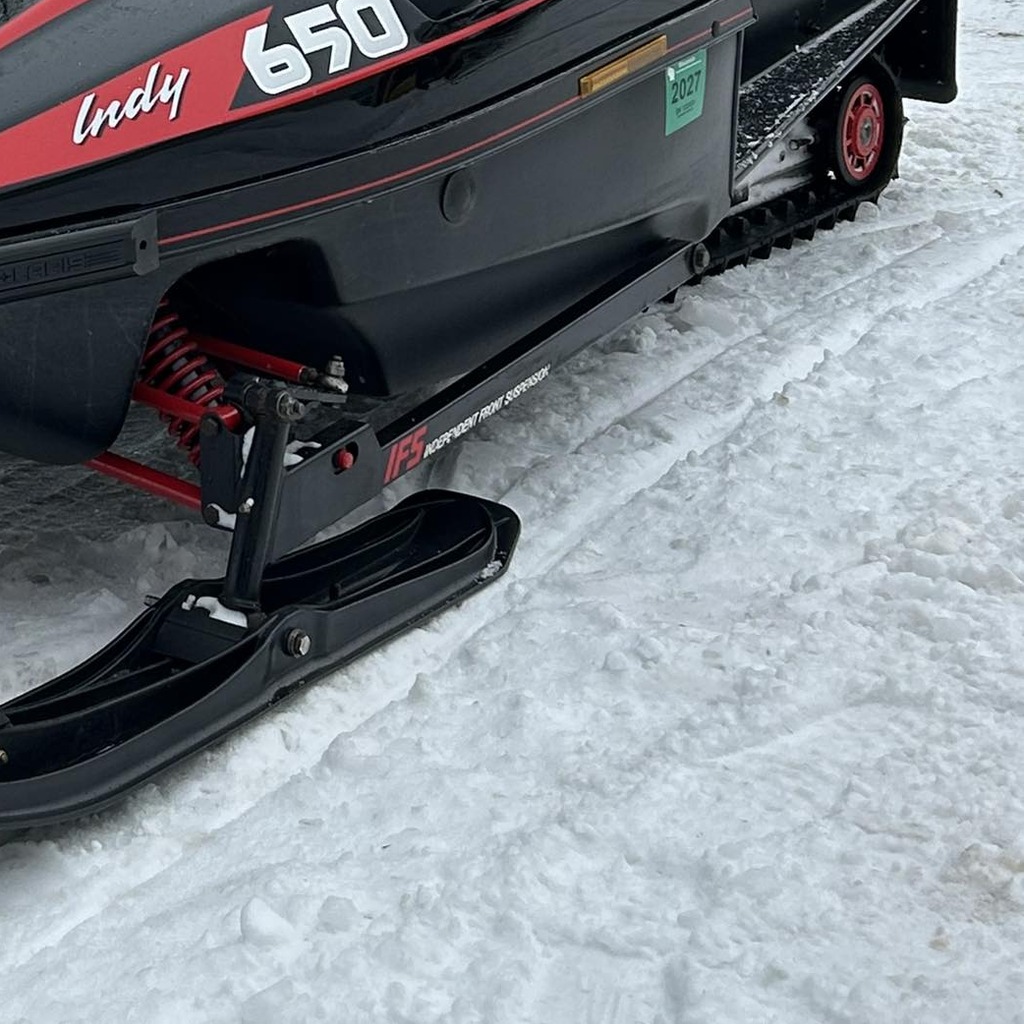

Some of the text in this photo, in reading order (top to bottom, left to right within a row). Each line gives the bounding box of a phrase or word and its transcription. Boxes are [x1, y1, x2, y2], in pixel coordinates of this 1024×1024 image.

[72, 61, 190, 145] Indy
[671, 70, 702, 104] 2027
[383, 363, 552, 486] IFS INDEPENDENT FRONT SUSPENSION
